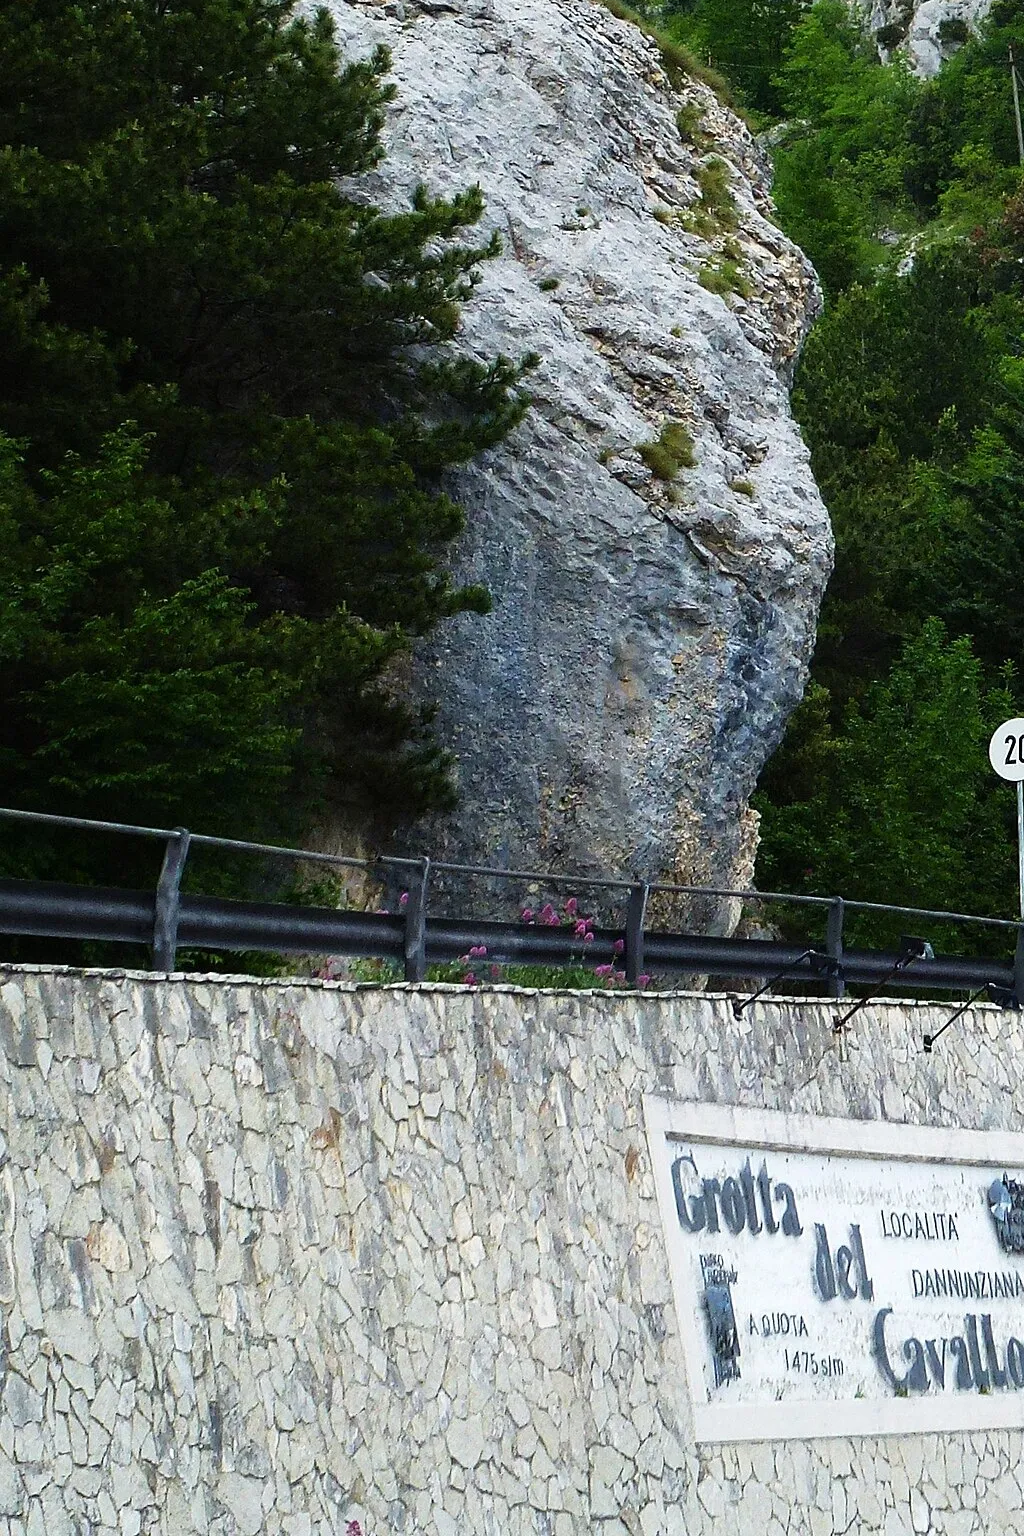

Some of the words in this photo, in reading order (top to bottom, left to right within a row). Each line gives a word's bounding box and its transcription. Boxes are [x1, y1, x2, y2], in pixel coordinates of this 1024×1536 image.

[671, 1156, 804, 1237] Grotta
[813, 1222, 875, 1302] del
[749, 1313, 760, 1335] A
[762, 1312, 809, 1337] QUOTA
